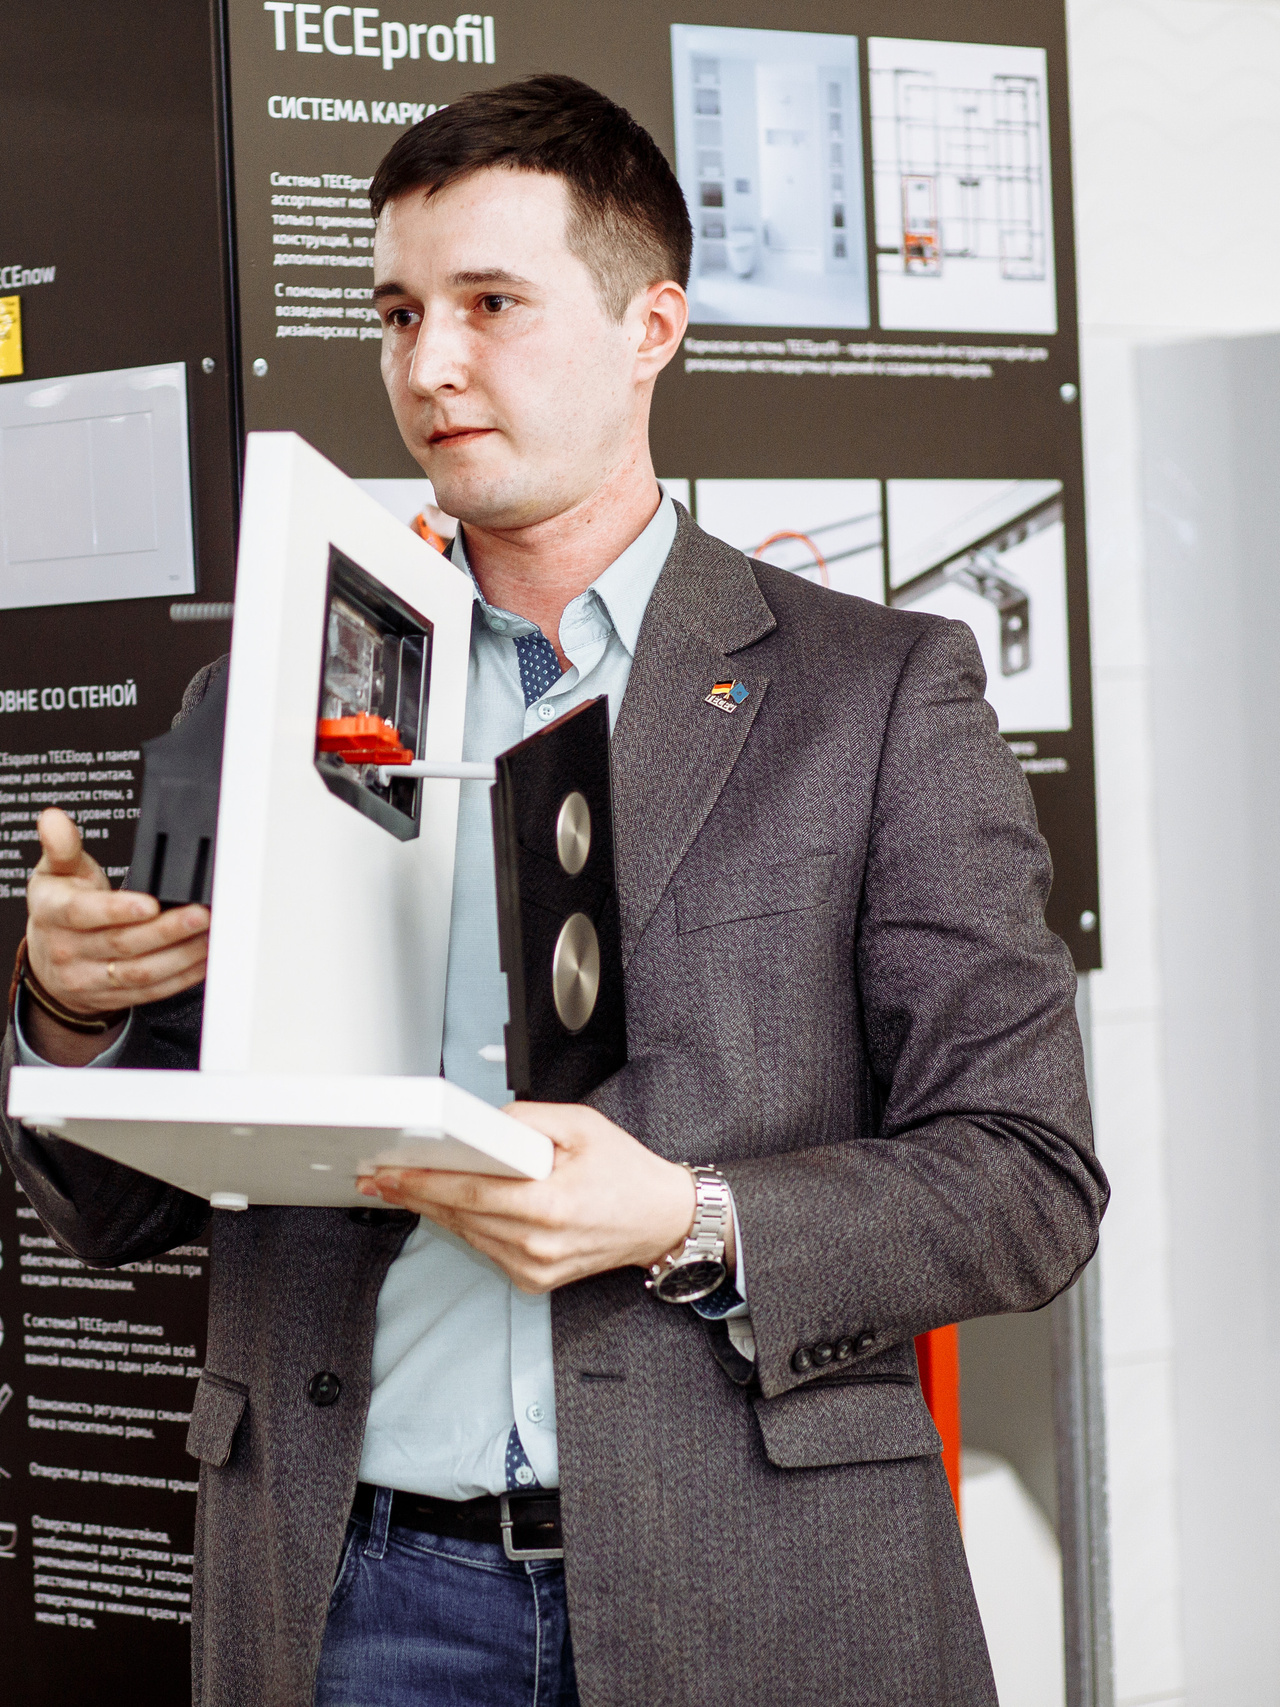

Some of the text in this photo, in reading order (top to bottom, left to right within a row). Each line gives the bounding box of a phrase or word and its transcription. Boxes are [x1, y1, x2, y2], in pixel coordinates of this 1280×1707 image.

[264, 1, 496, 70] TECEprofil
[268, 95, 369, 123] СИСТЕМА
[41, 688, 65, 710] СО
[68, 679, 137, 708] СТЕНОЙ
